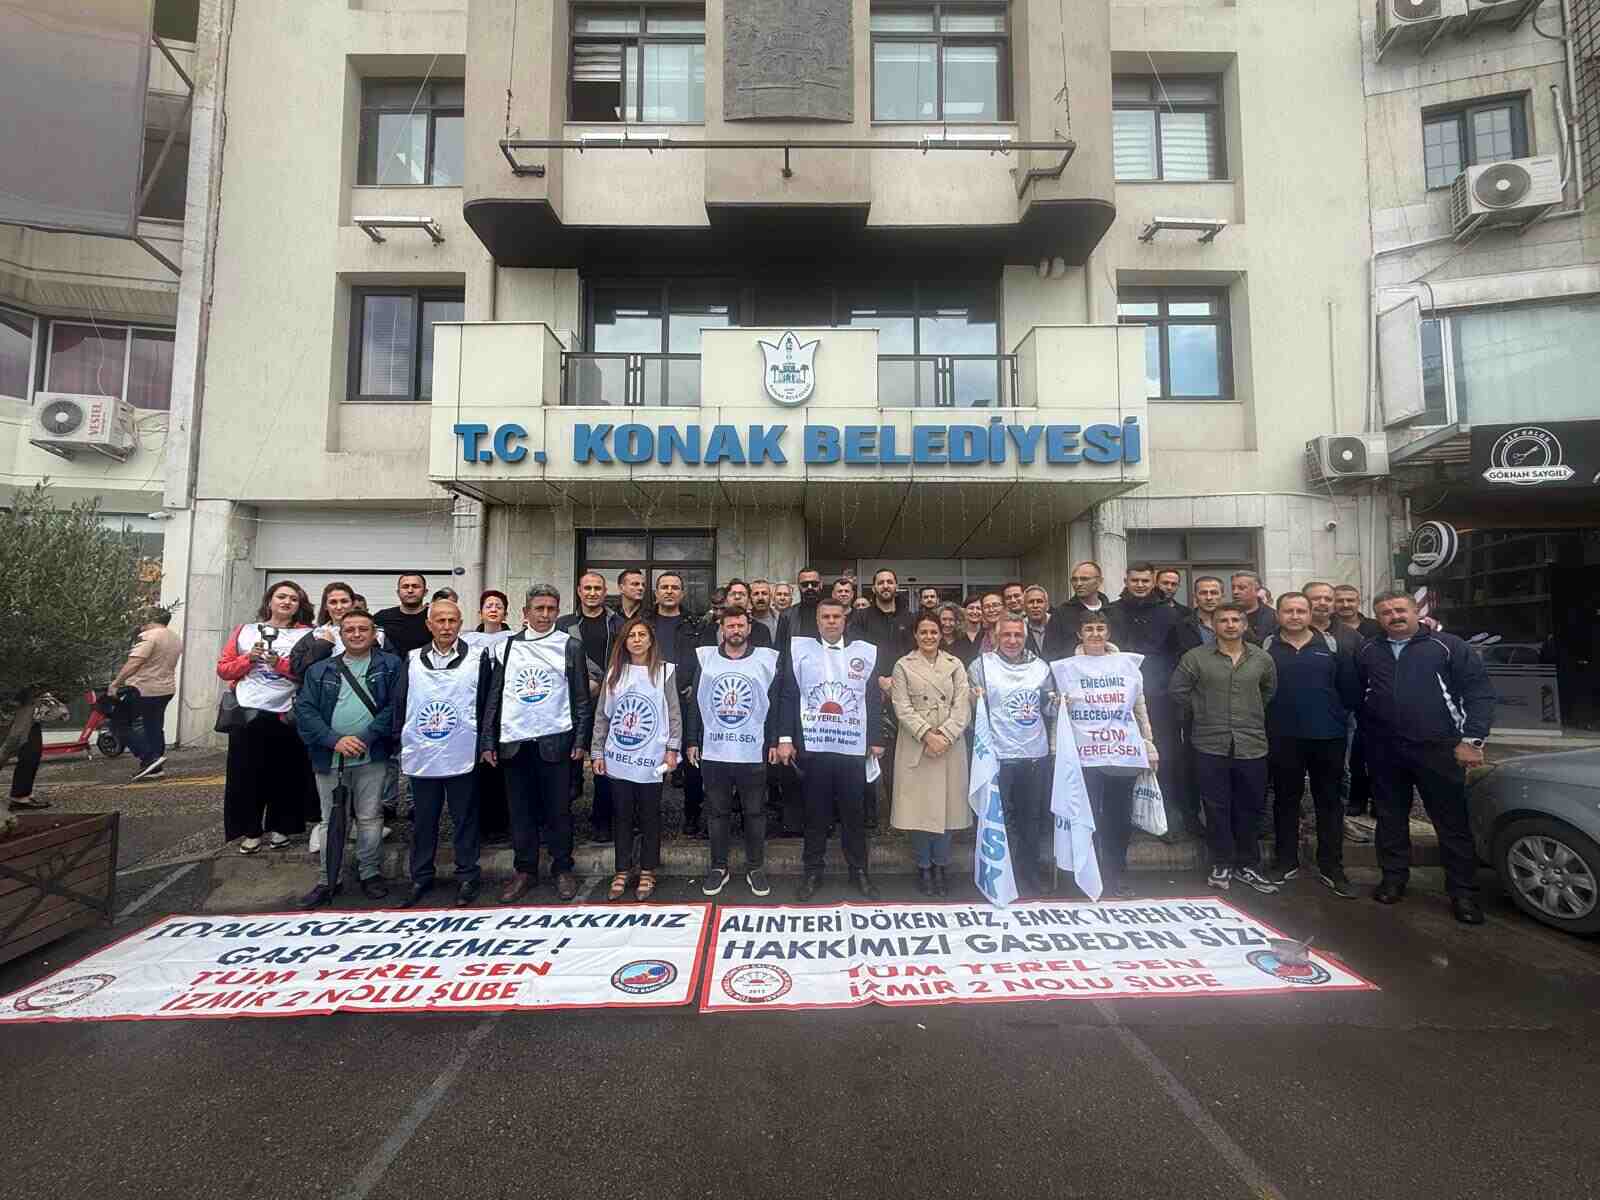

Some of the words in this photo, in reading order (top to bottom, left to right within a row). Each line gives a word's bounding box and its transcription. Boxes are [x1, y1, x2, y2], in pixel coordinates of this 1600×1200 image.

[88, 404, 102, 435] VESTEL
[454, 423, 547, 464] T.C.
[573, 424, 787, 465] KONAK
[804, 416, 1141, 465] BELEDİYESİ
[615, 752, 656, 767] BEL-SEN
[145, 921, 286, 941] TOPLU
[284, 914, 493, 938] SÖZLEŞME
[496, 912, 691, 930] HAKKIMIZ
[720, 910, 842, 933] ALINTERİ
[851, 909, 948, 930] DÖKEN
[954, 907, 1009, 930] BİZ,
[1015, 906, 1091, 927] EMEK
[1094, 905, 1182, 925] VEREN
[1177, 902, 1243, 923] BİZ,
[216, 944, 341, 965] GASP
[338, 935, 546, 962] EDİLEMEZ
[550, 937, 571, 955] !
[722, 934, 952, 960] HAKKIMIZI
[965, 930, 1187, 953] GASBEDEN
[190, 967, 298, 986] TÜM
[316, 961, 443, 982] YEREL
[459, 961, 552, 977] SEN
[847, 962, 946, 977] TÜM
[956, 959, 1101, 975] YEREL
[1112, 958, 1208, 970] SEN
[160, 985, 277, 1011] İZMİR
[276, 990, 306, 1008] 2
[316, 985, 422, 1004] NOLU
[429, 981, 523, 1004] ŞUBE
[966, 980, 992, 993] 2
[1002, 975, 1115, 991] NOLU
[1124, 973, 1224, 991] ŞUBE
